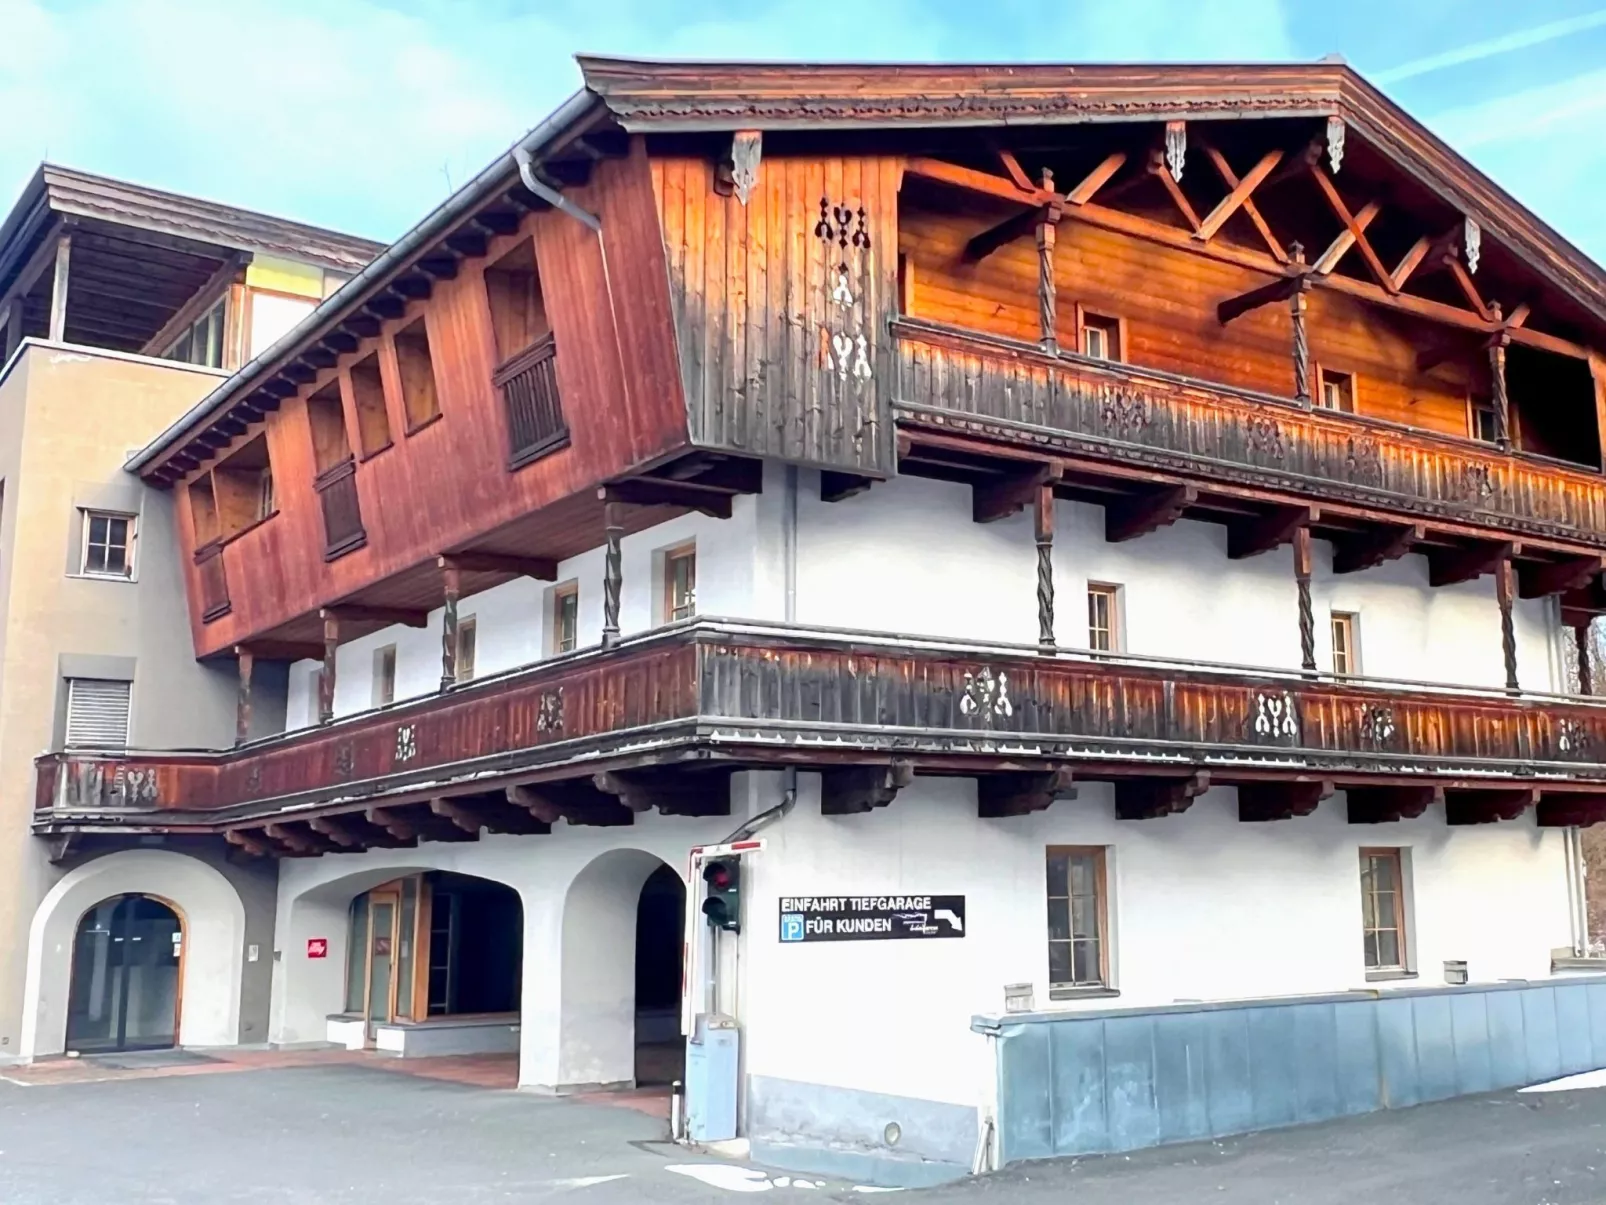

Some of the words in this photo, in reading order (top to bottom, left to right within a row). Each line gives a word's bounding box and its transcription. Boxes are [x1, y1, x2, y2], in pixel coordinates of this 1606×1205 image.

[781, 898, 847, 912] EINFAHRT
[851, 897, 931, 911] TIEFGARAGE
[788, 922, 799, 939] P
[806, 917, 833, 934] FÜR
[836, 919, 892, 933] KUNDEN
